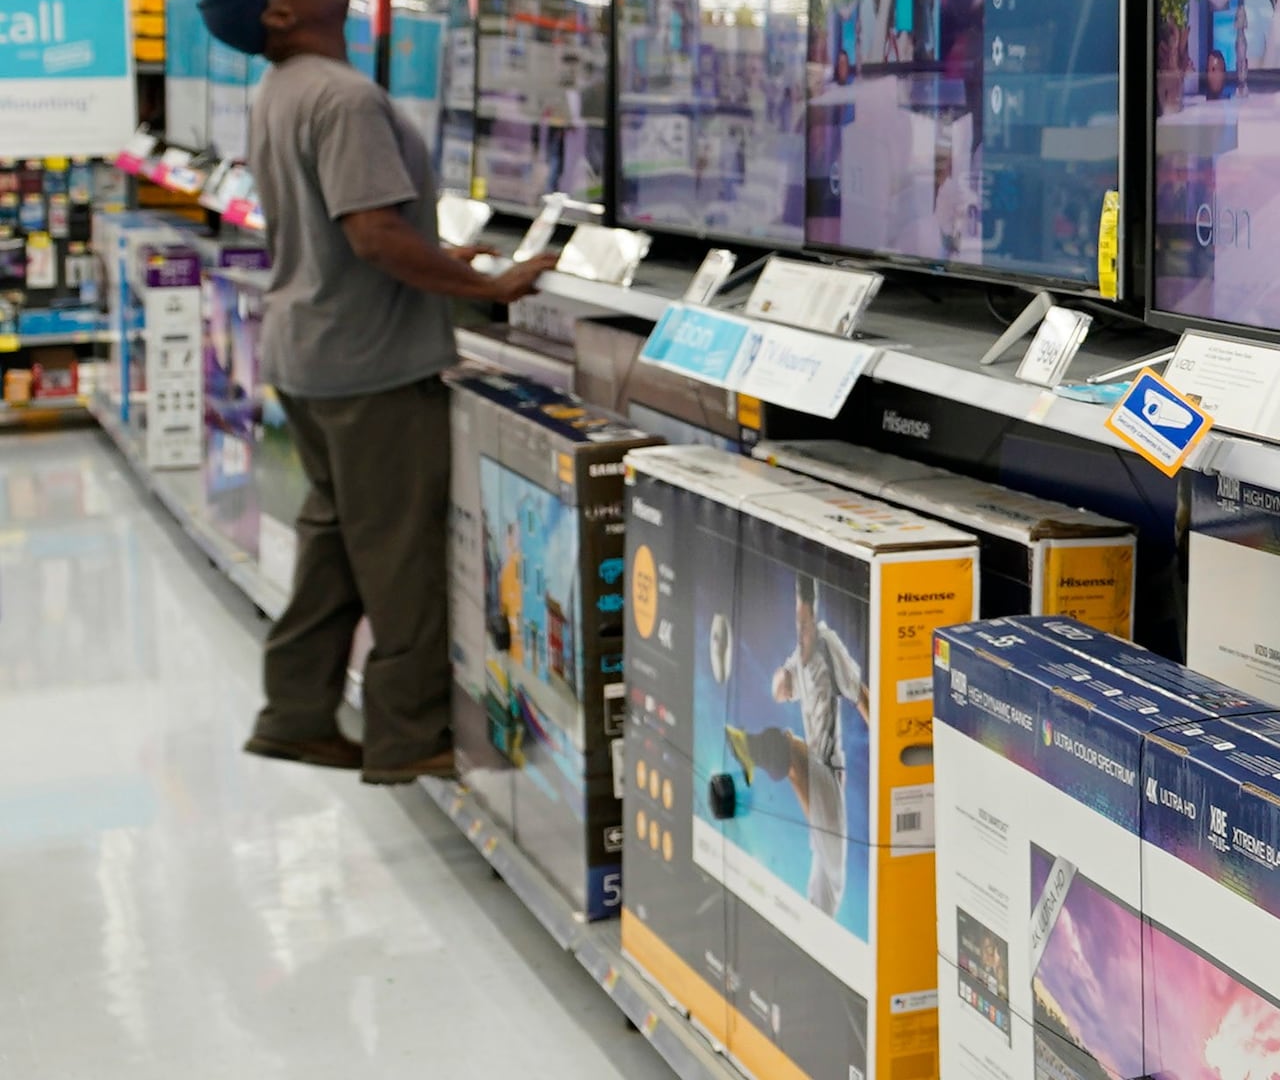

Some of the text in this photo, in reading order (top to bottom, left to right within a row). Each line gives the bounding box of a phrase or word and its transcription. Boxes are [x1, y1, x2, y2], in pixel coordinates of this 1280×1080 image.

[882, 409, 931, 439] Hisense
[1243, 489, 1264, 508] HIGH
[896, 591, 956, 604] Hisense
[1059, 576, 1117, 589] Hisense
[1054, 730, 1074, 753] ULTRA
[1074, 738, 1100, 766] COLOR
[1145, 776, 1197, 820] 4K ULTRA HD
[1210, 804, 1228, 838] XBE
[1232, 829, 1266, 860] XTREME
